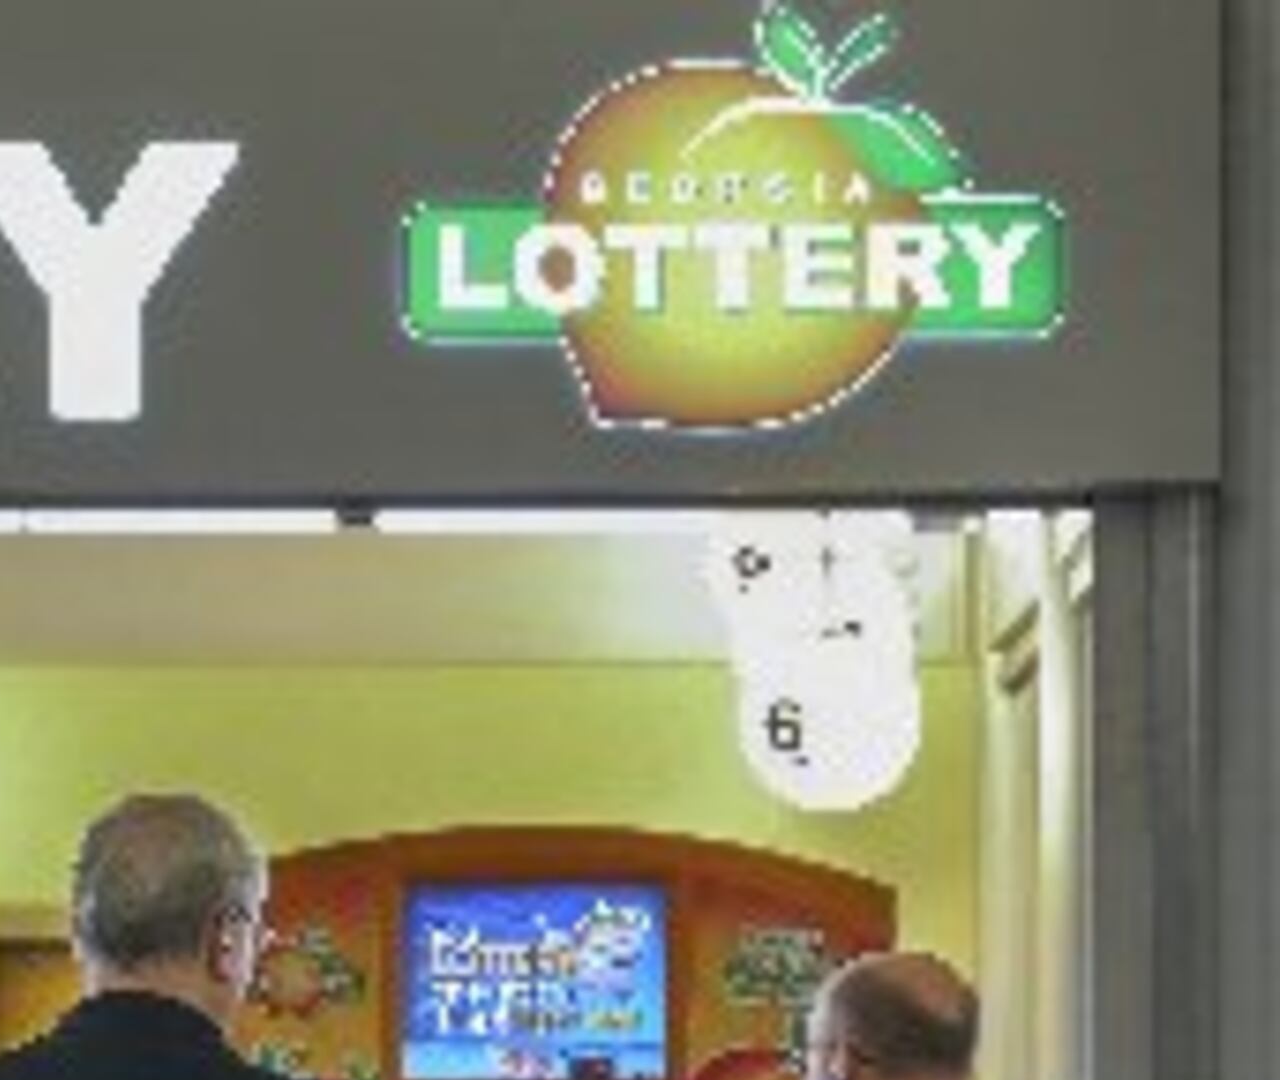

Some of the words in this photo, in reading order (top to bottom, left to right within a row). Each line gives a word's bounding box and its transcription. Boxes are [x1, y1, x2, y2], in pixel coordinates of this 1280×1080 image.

[580, 171, 871, 204] GEORGIA
[438, 222, 1042, 311] LOTTERY
[764, 697, 802, 753] 6
